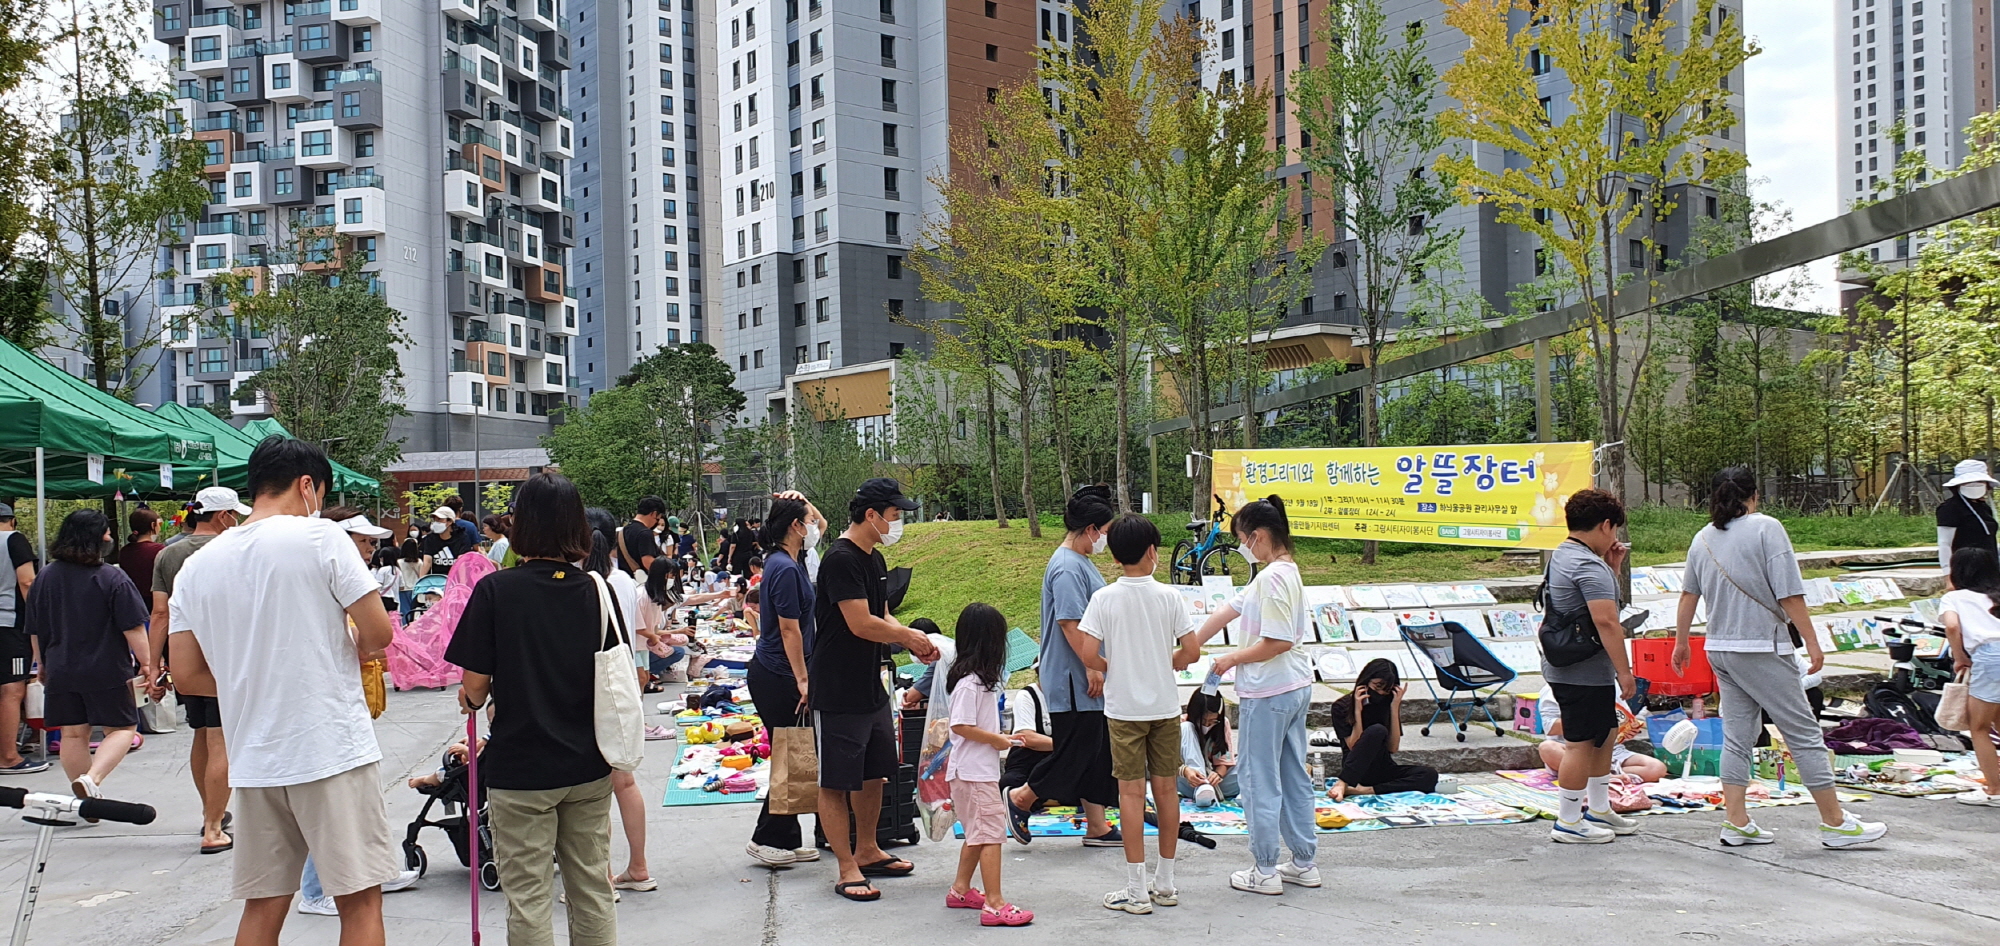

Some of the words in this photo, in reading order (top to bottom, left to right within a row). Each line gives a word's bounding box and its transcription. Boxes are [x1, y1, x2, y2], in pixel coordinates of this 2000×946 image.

[760, 181, 775, 202] 210
[403, 245, 417, 262] 212
[1245, 462, 1314, 484] 환경그리기와
[1326, 461, 1380, 486] 함께하는
[1396, 453, 1536, 495] 알뜰장터
[1421, 503, 1434, 511] 장소
[1474, 504, 1508, 515] 관리사무실
[1510, 505, 1517, 515] 앞
[1354, 523, 1367, 532] 주관
